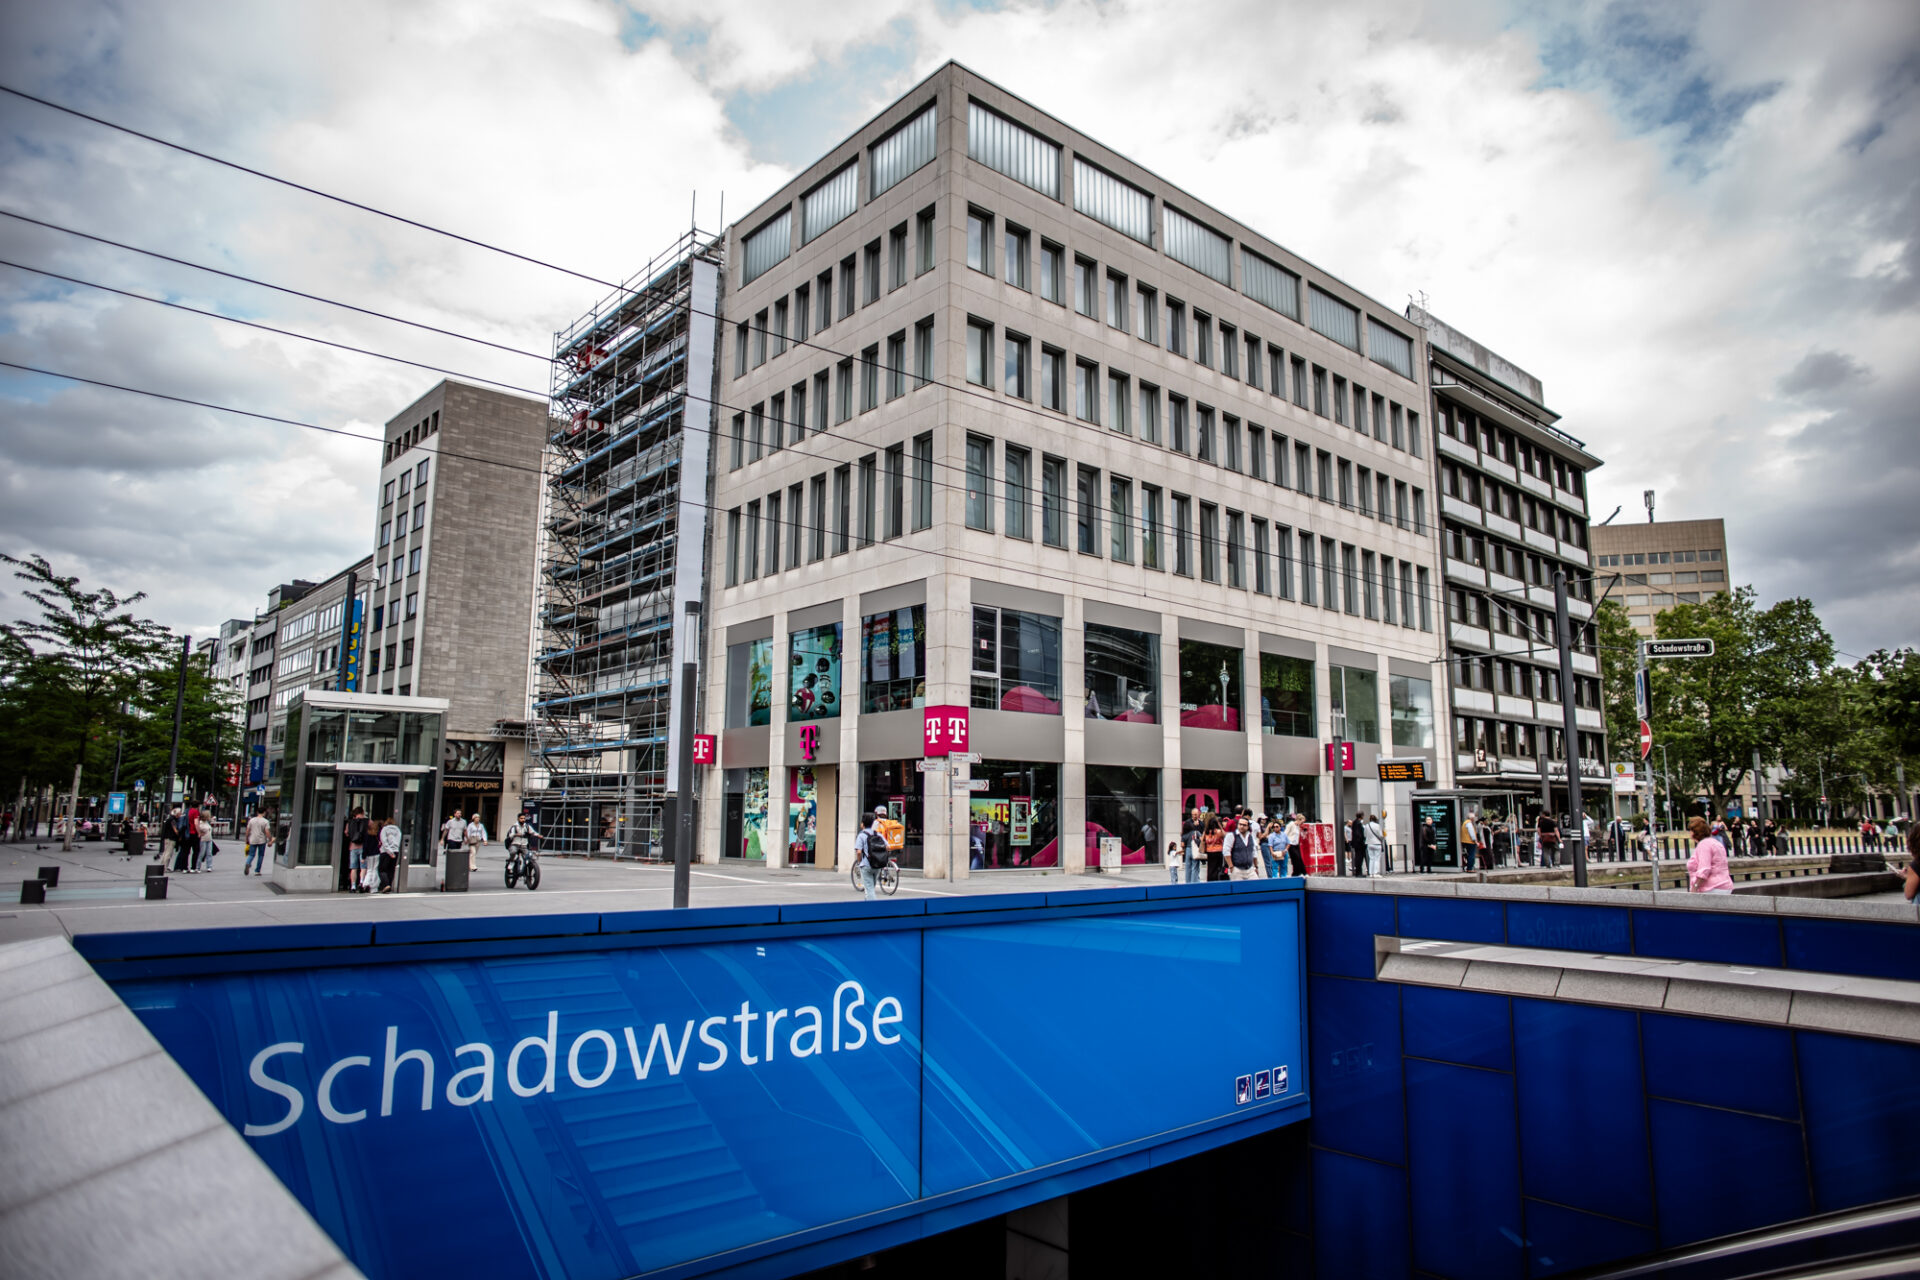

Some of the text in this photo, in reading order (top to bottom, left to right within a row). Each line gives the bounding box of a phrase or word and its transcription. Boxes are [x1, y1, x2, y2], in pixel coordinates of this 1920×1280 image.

[1653, 643, 1705, 653] Schadowstraße
[800, 725, 816, 760] T
[926, 717, 941, 744] T
[948, 717, 966, 744] T
[244, 980, 903, 1137] Schadowstraße
